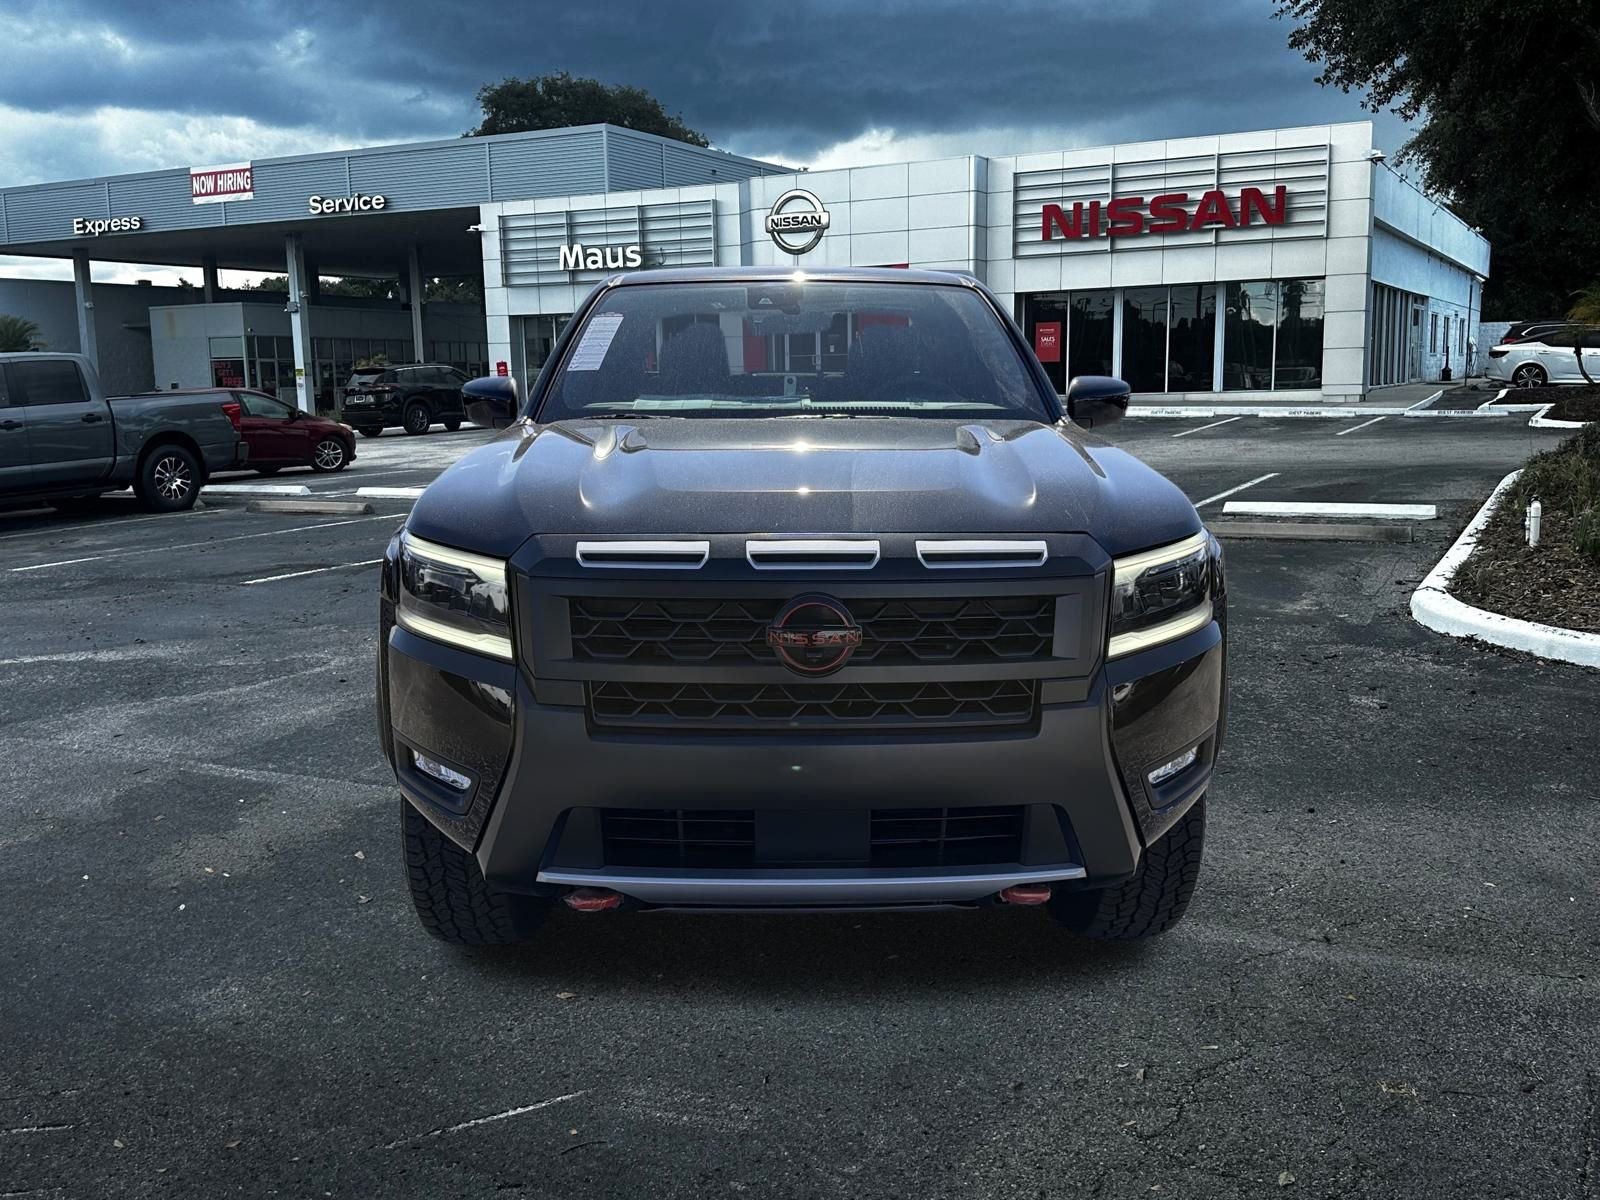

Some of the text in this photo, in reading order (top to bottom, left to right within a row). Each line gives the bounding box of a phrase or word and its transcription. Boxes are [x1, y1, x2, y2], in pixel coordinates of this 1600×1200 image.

[192, 171, 251, 195] NOW HIRING
[309, 193, 385, 214] Service
[1042, 185, 1287, 241] NISSAN
[73, 216, 141, 236] Express
[770, 215, 822, 228] NISSAN
[560, 243, 642, 270] Maus
[768, 631, 859, 645] NISSAN
